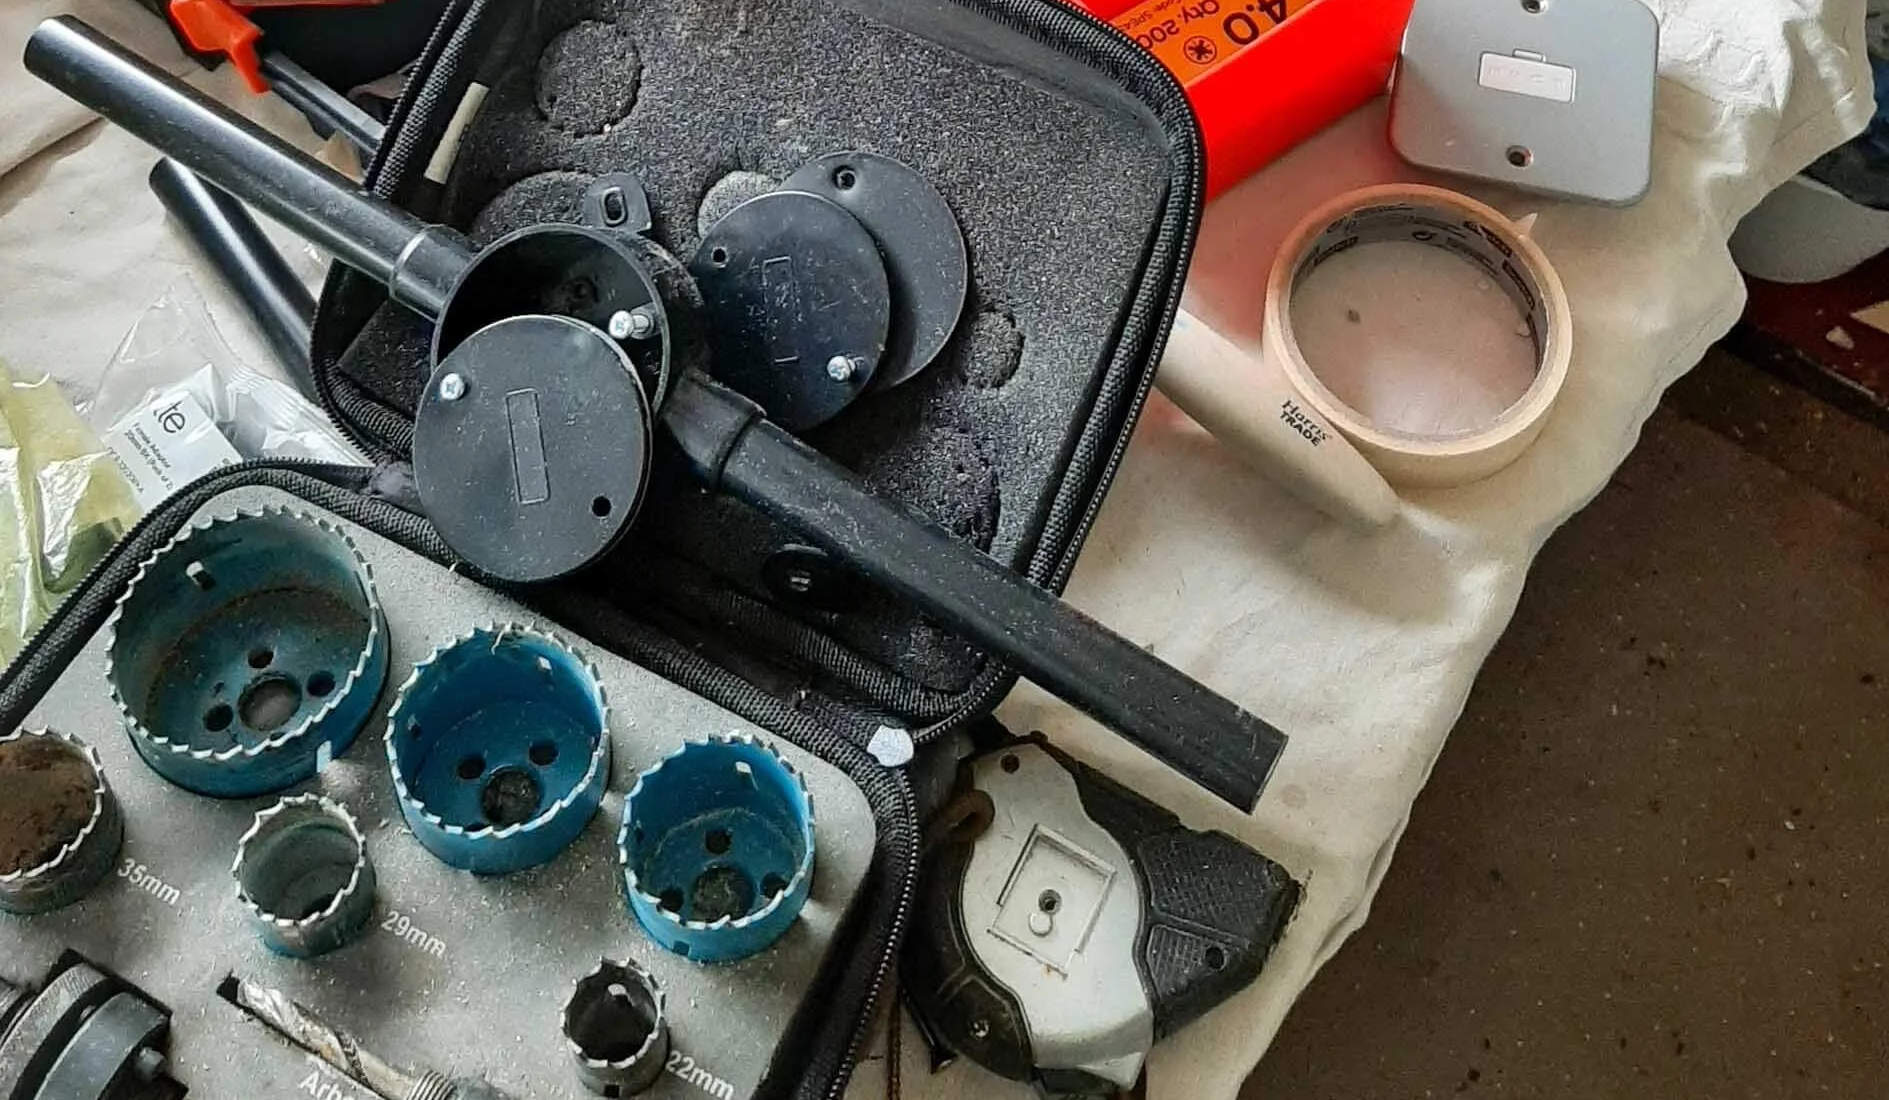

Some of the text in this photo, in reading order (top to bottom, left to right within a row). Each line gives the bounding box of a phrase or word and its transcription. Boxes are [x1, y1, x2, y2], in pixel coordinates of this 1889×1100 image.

[1136, 19, 1180, 49] 200
[1280, 411, 1320, 446] TRADE
[1282, 400, 1328, 440] Harris
[117, 857, 181, 906] 35mm
[380, 910, 447, 958] 29mm
[299, 1071, 355, 1100] Arb
[665, 1050, 734, 1100] 22mm
